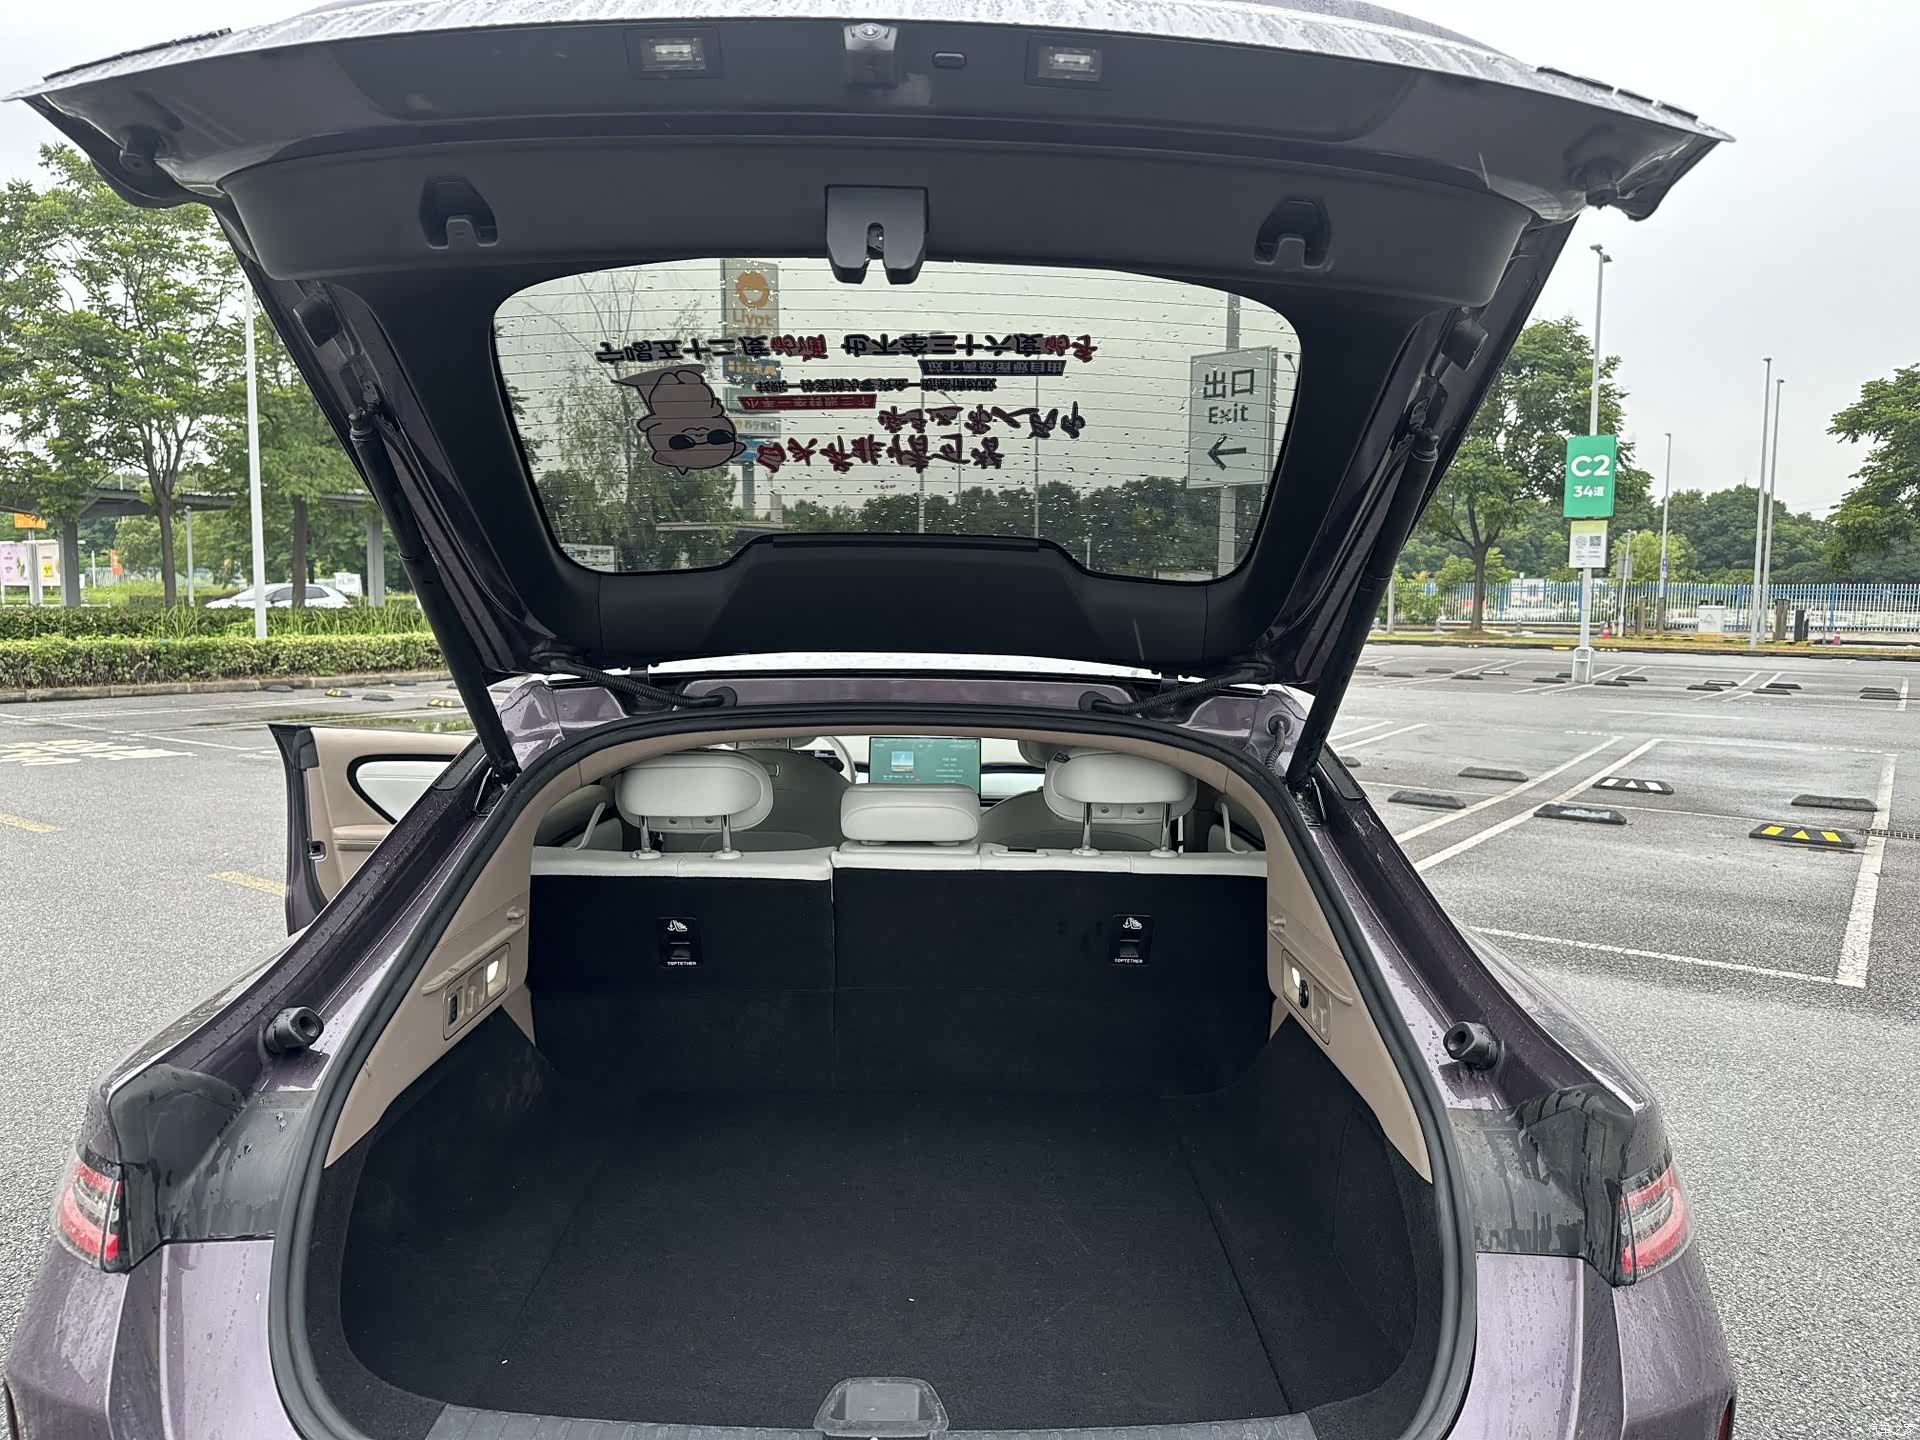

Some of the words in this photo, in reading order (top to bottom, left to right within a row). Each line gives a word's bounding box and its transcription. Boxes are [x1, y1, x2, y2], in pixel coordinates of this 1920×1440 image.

[1203, 369, 1254, 398] 出口
[1208, 403, 1249, 424] Exit
[1571, 455, 1611, 477] C2
